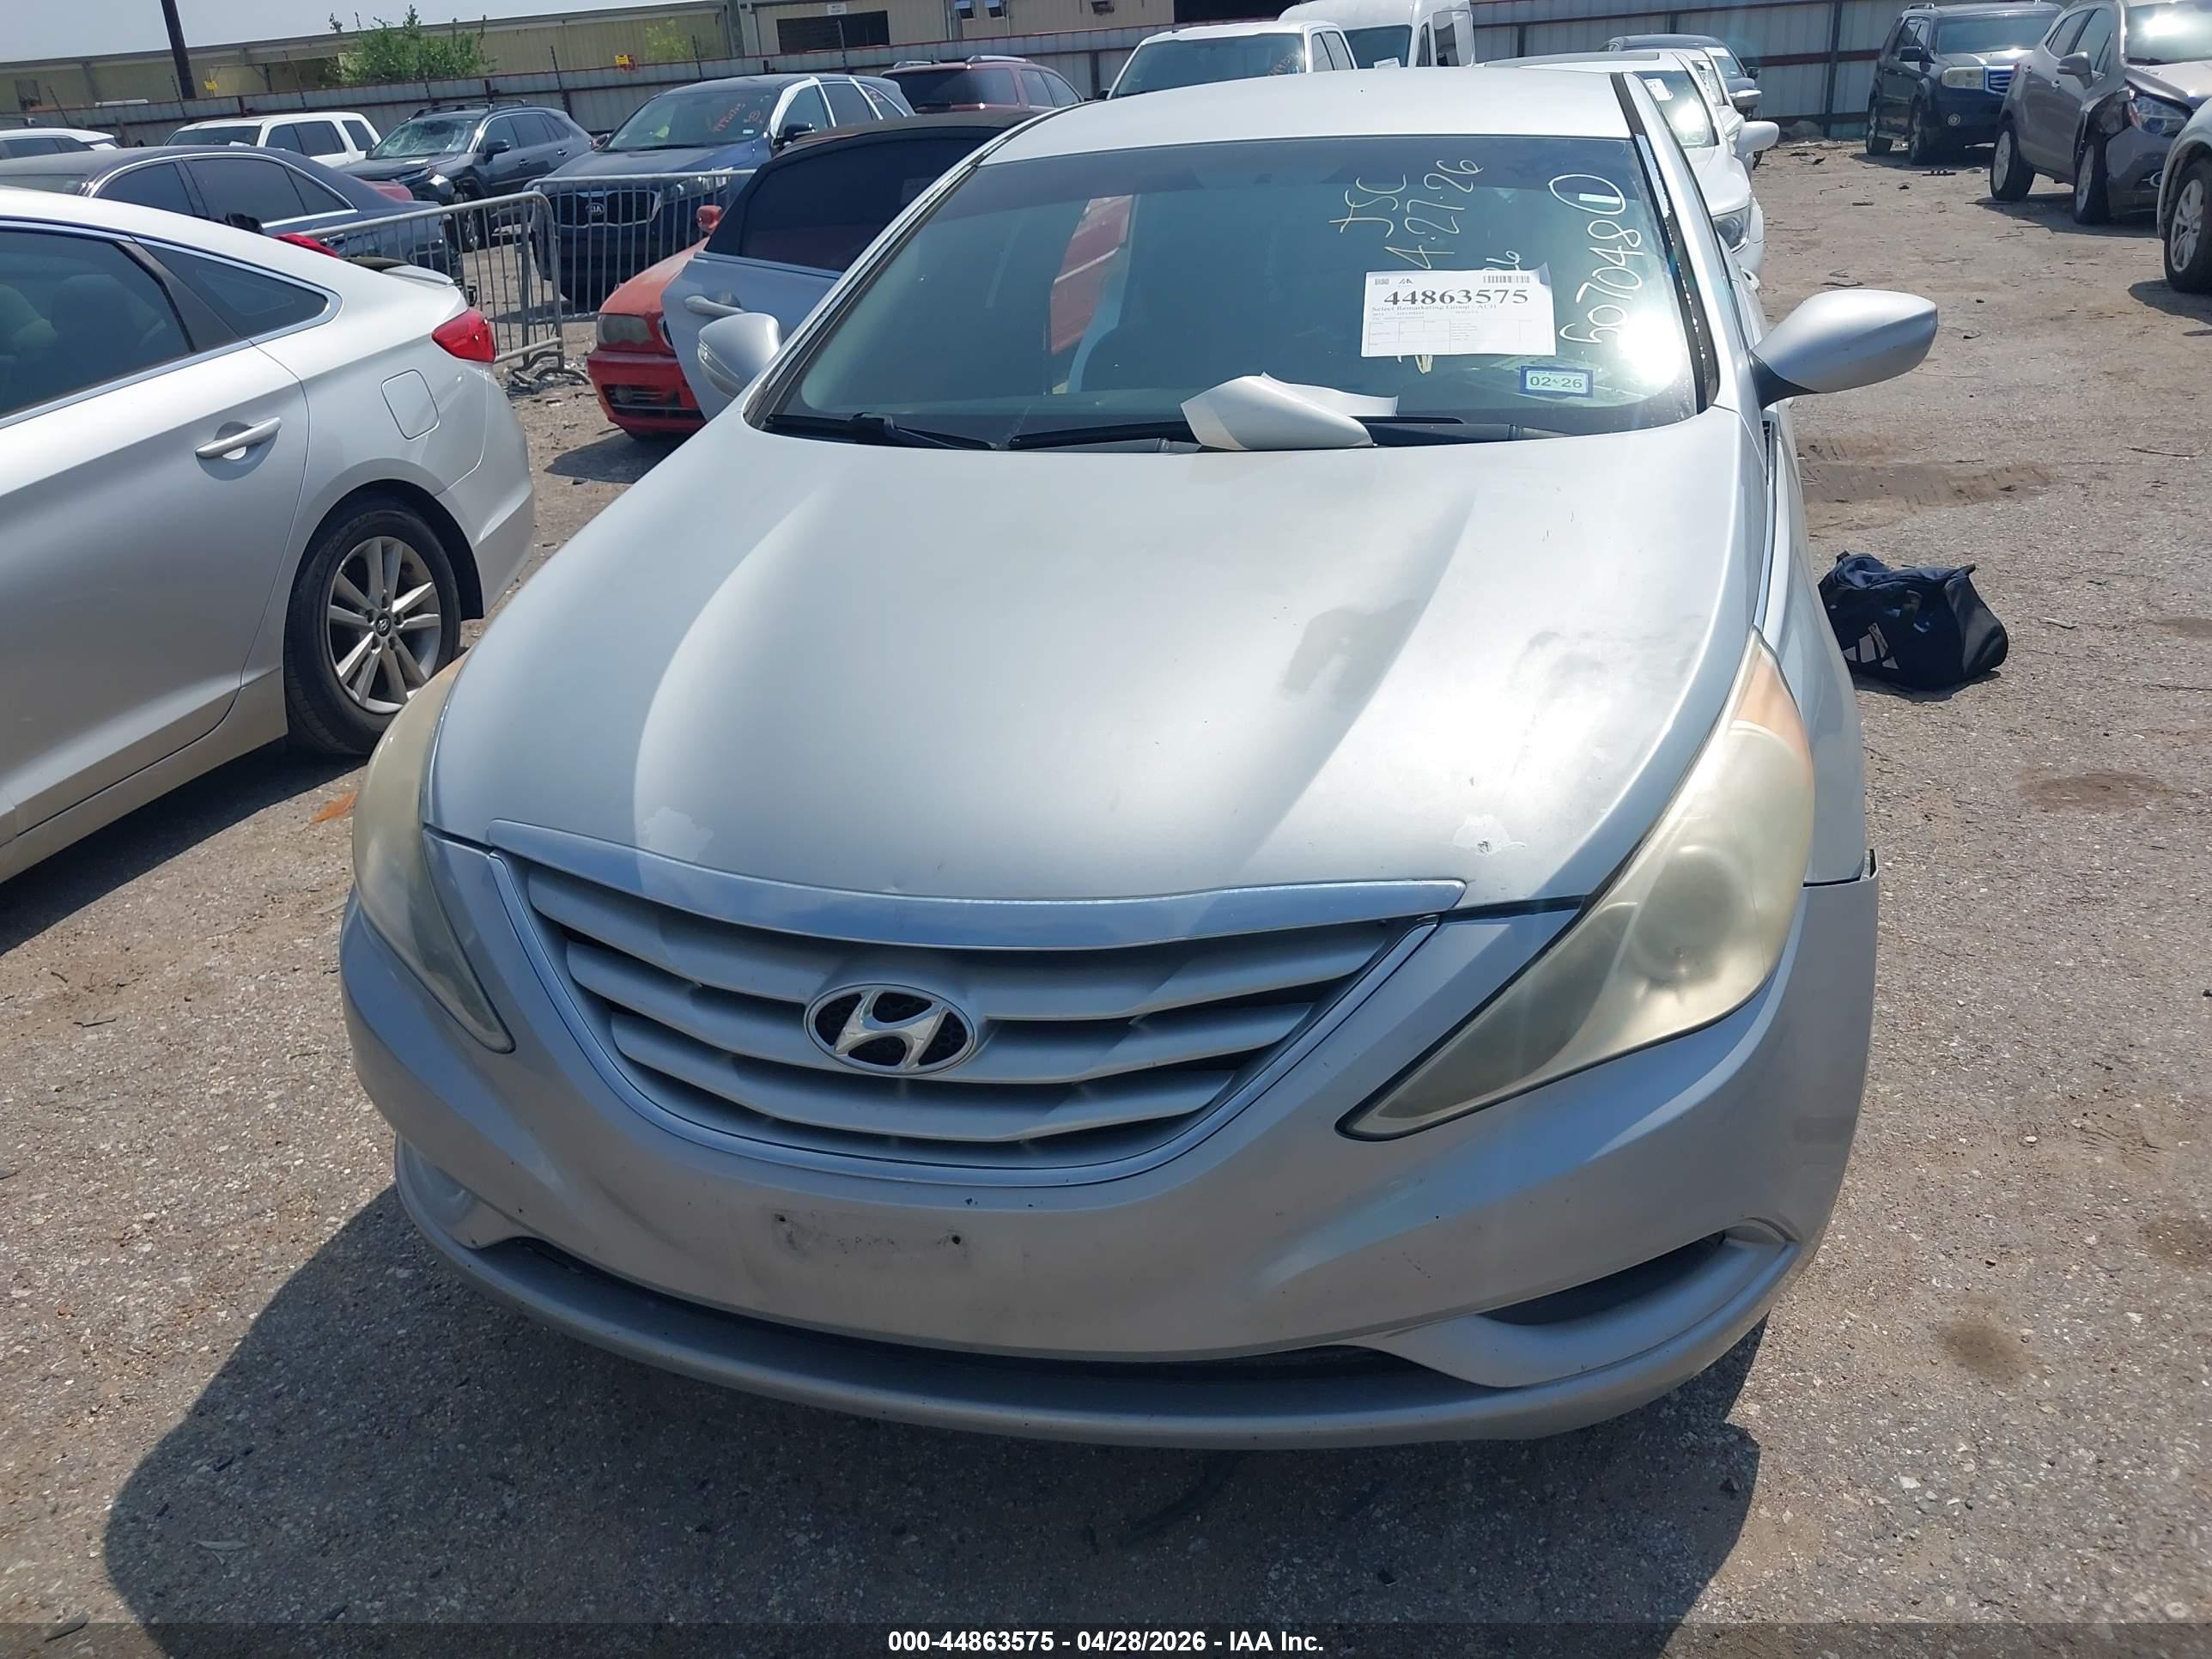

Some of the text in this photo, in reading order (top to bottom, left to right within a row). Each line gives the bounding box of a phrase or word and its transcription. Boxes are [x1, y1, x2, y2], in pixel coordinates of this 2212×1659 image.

[1383, 289, 1528, 306] 44863575
[1529, 376, 1583, 389] 02 26
